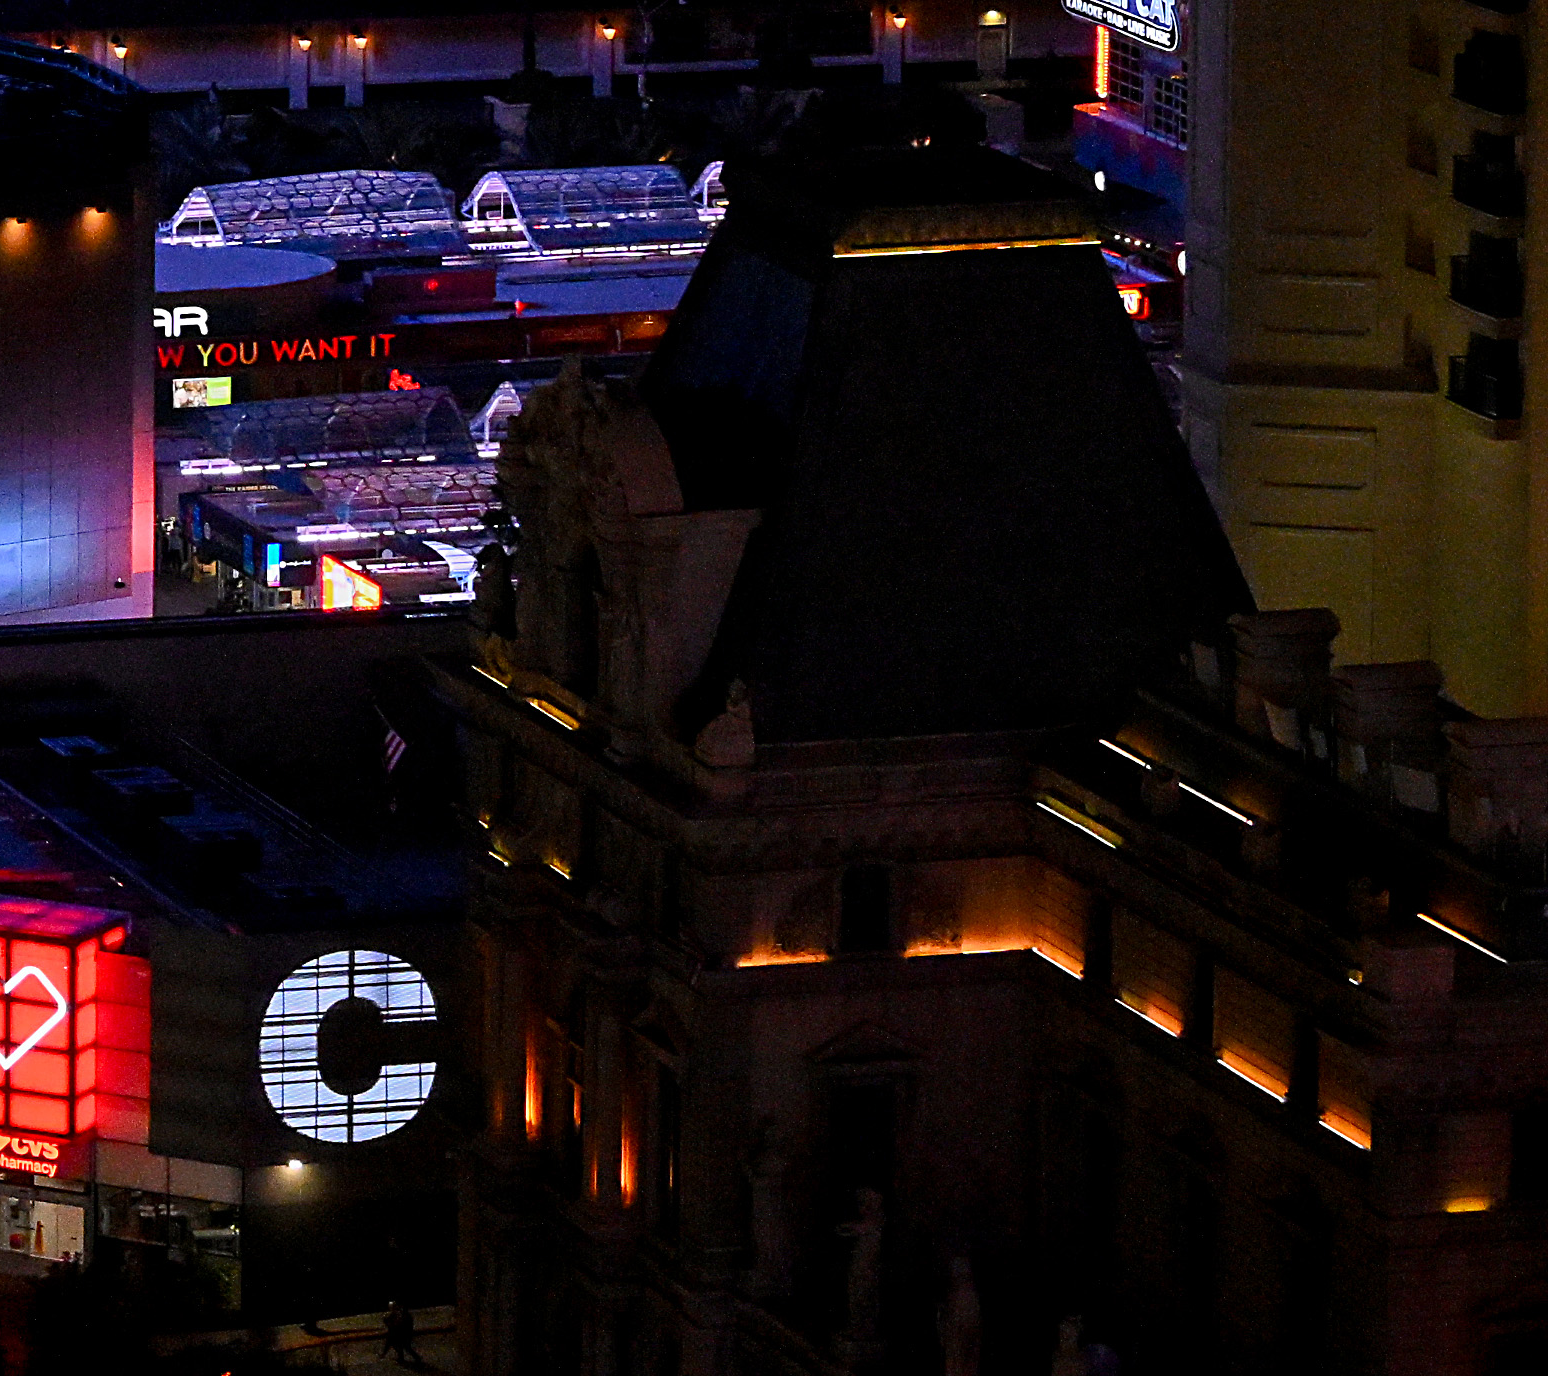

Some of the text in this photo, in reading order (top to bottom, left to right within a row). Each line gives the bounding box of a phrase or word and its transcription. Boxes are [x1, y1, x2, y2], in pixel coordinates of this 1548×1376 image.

[1107, 11, 1124, 27] BAR
[1128, 18, 1146, 36] LIVE
[195, 341, 259, 368] YOU
[270, 335, 359, 363] WANT
[369, 333, 397, 358] IT
[259, 949, 438, 1144] C
[10, 1137, 60, 1162] CVS
